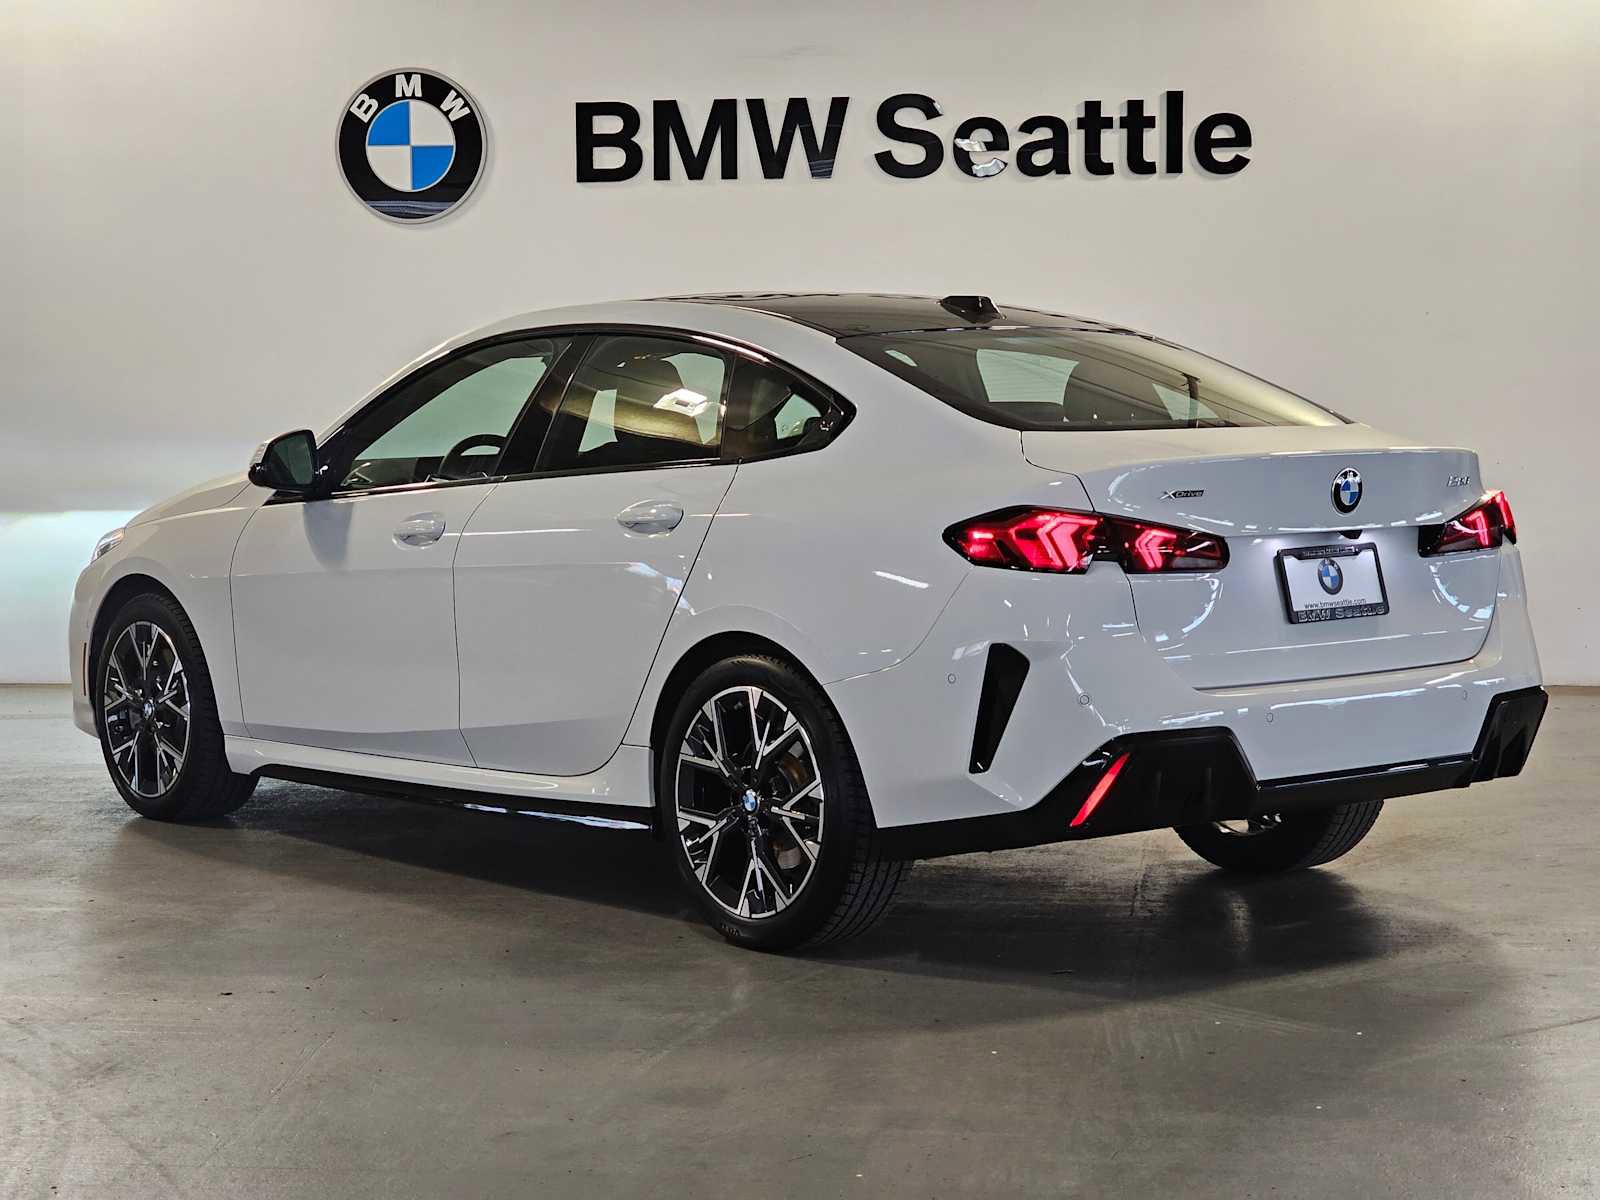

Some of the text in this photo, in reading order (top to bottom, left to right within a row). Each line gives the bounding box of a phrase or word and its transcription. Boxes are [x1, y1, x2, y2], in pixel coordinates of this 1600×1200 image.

[350, 74, 471, 123] BMW
[575, 90, 1253, 183] BMW Seattle
[1298, 605, 1385, 622] BMW Seattle
